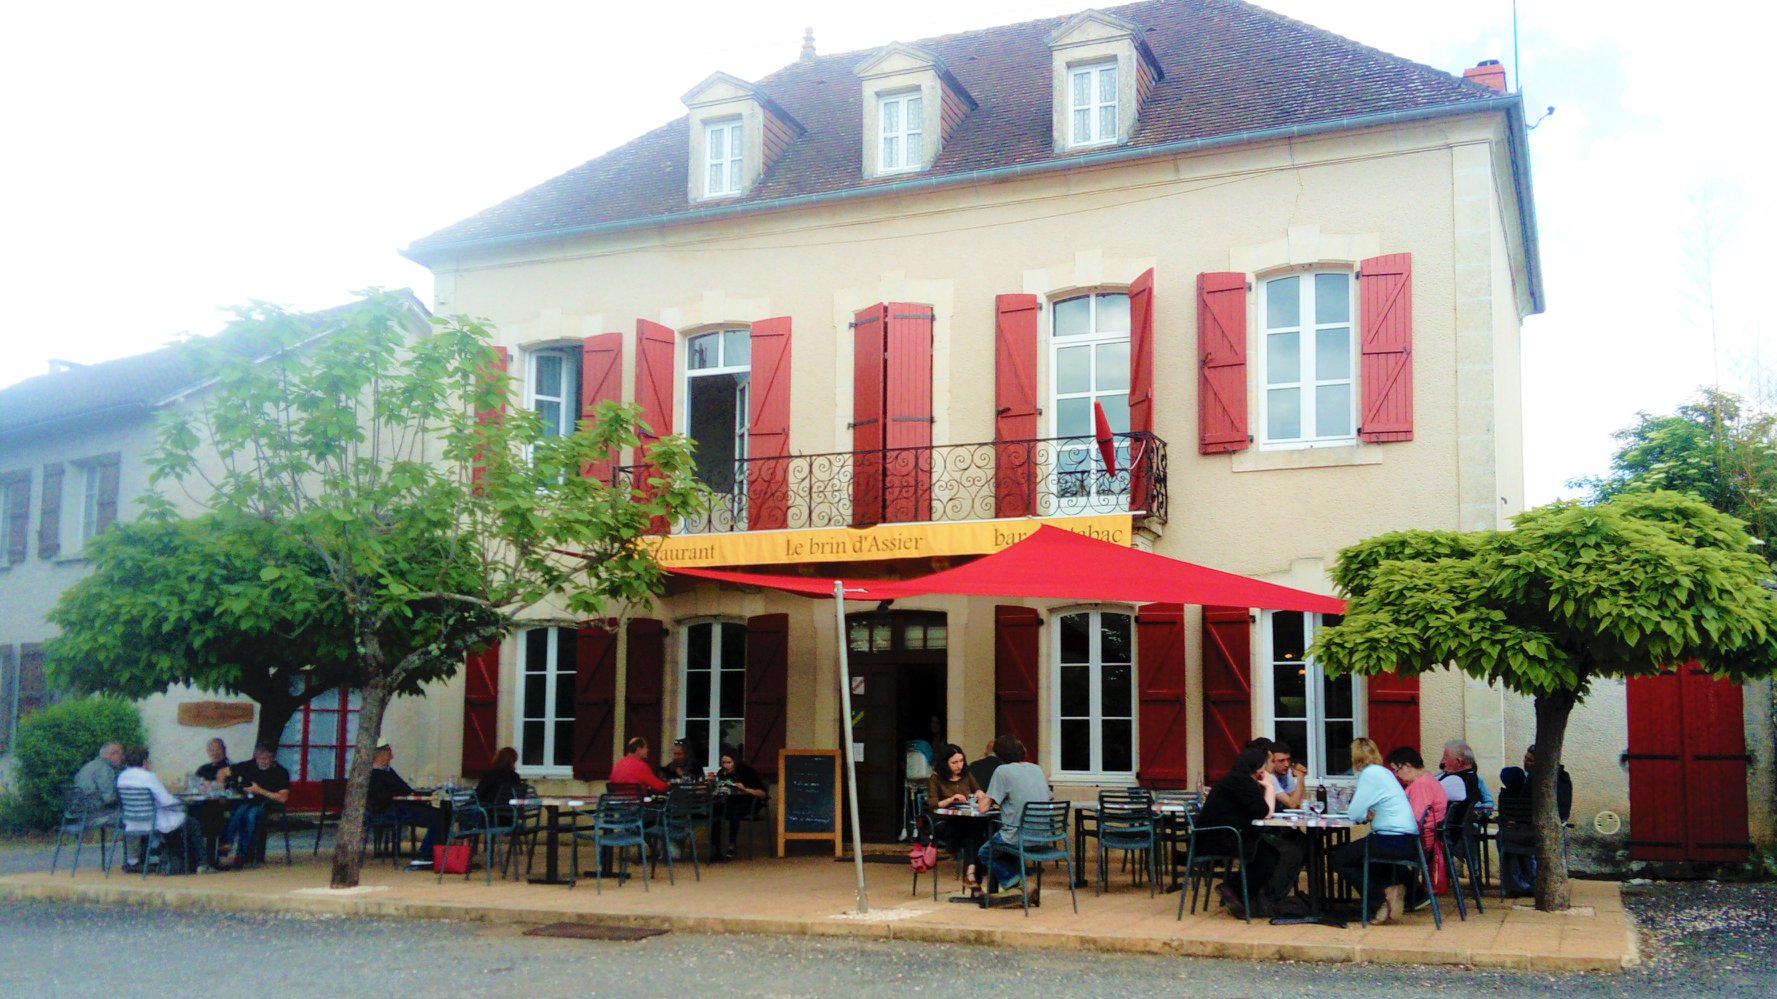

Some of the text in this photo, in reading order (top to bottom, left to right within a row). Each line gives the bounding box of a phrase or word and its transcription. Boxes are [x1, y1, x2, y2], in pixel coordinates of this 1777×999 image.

[785, 538, 804, 556] Le
[809, 536, 847, 555] brin
[852, 533, 924, 554] d'Assier
[994, 528, 1027, 546] bar
